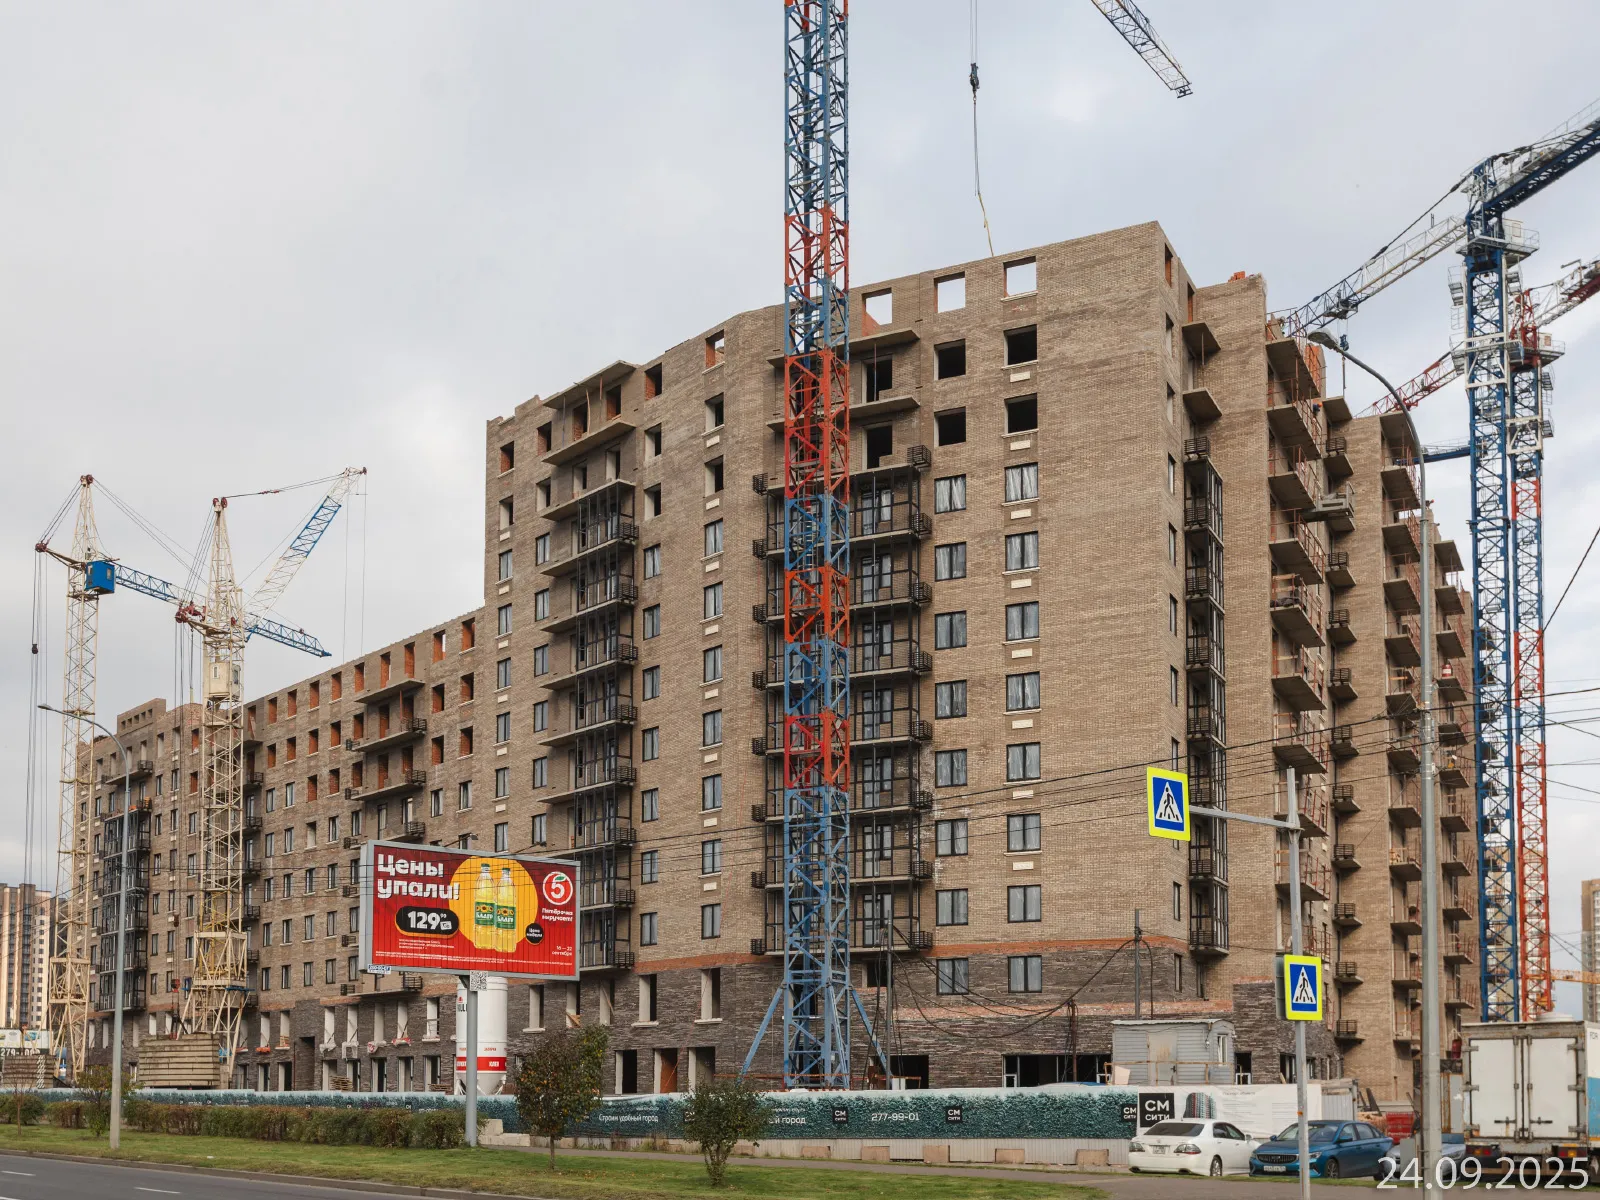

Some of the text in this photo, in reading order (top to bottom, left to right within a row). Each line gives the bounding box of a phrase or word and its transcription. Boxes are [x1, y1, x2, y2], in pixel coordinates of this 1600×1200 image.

[378, 854, 443, 877] Цены
[378, 879, 460, 900] упали!
[408, 911, 440, 930] 129
[1145, 1100, 1169, 1112] СМ
[598, 1113, 659, 1123] Строим удобный город
[782, 1117, 806, 1125] город
[871, 1113, 920, 1121] 277-99-01
